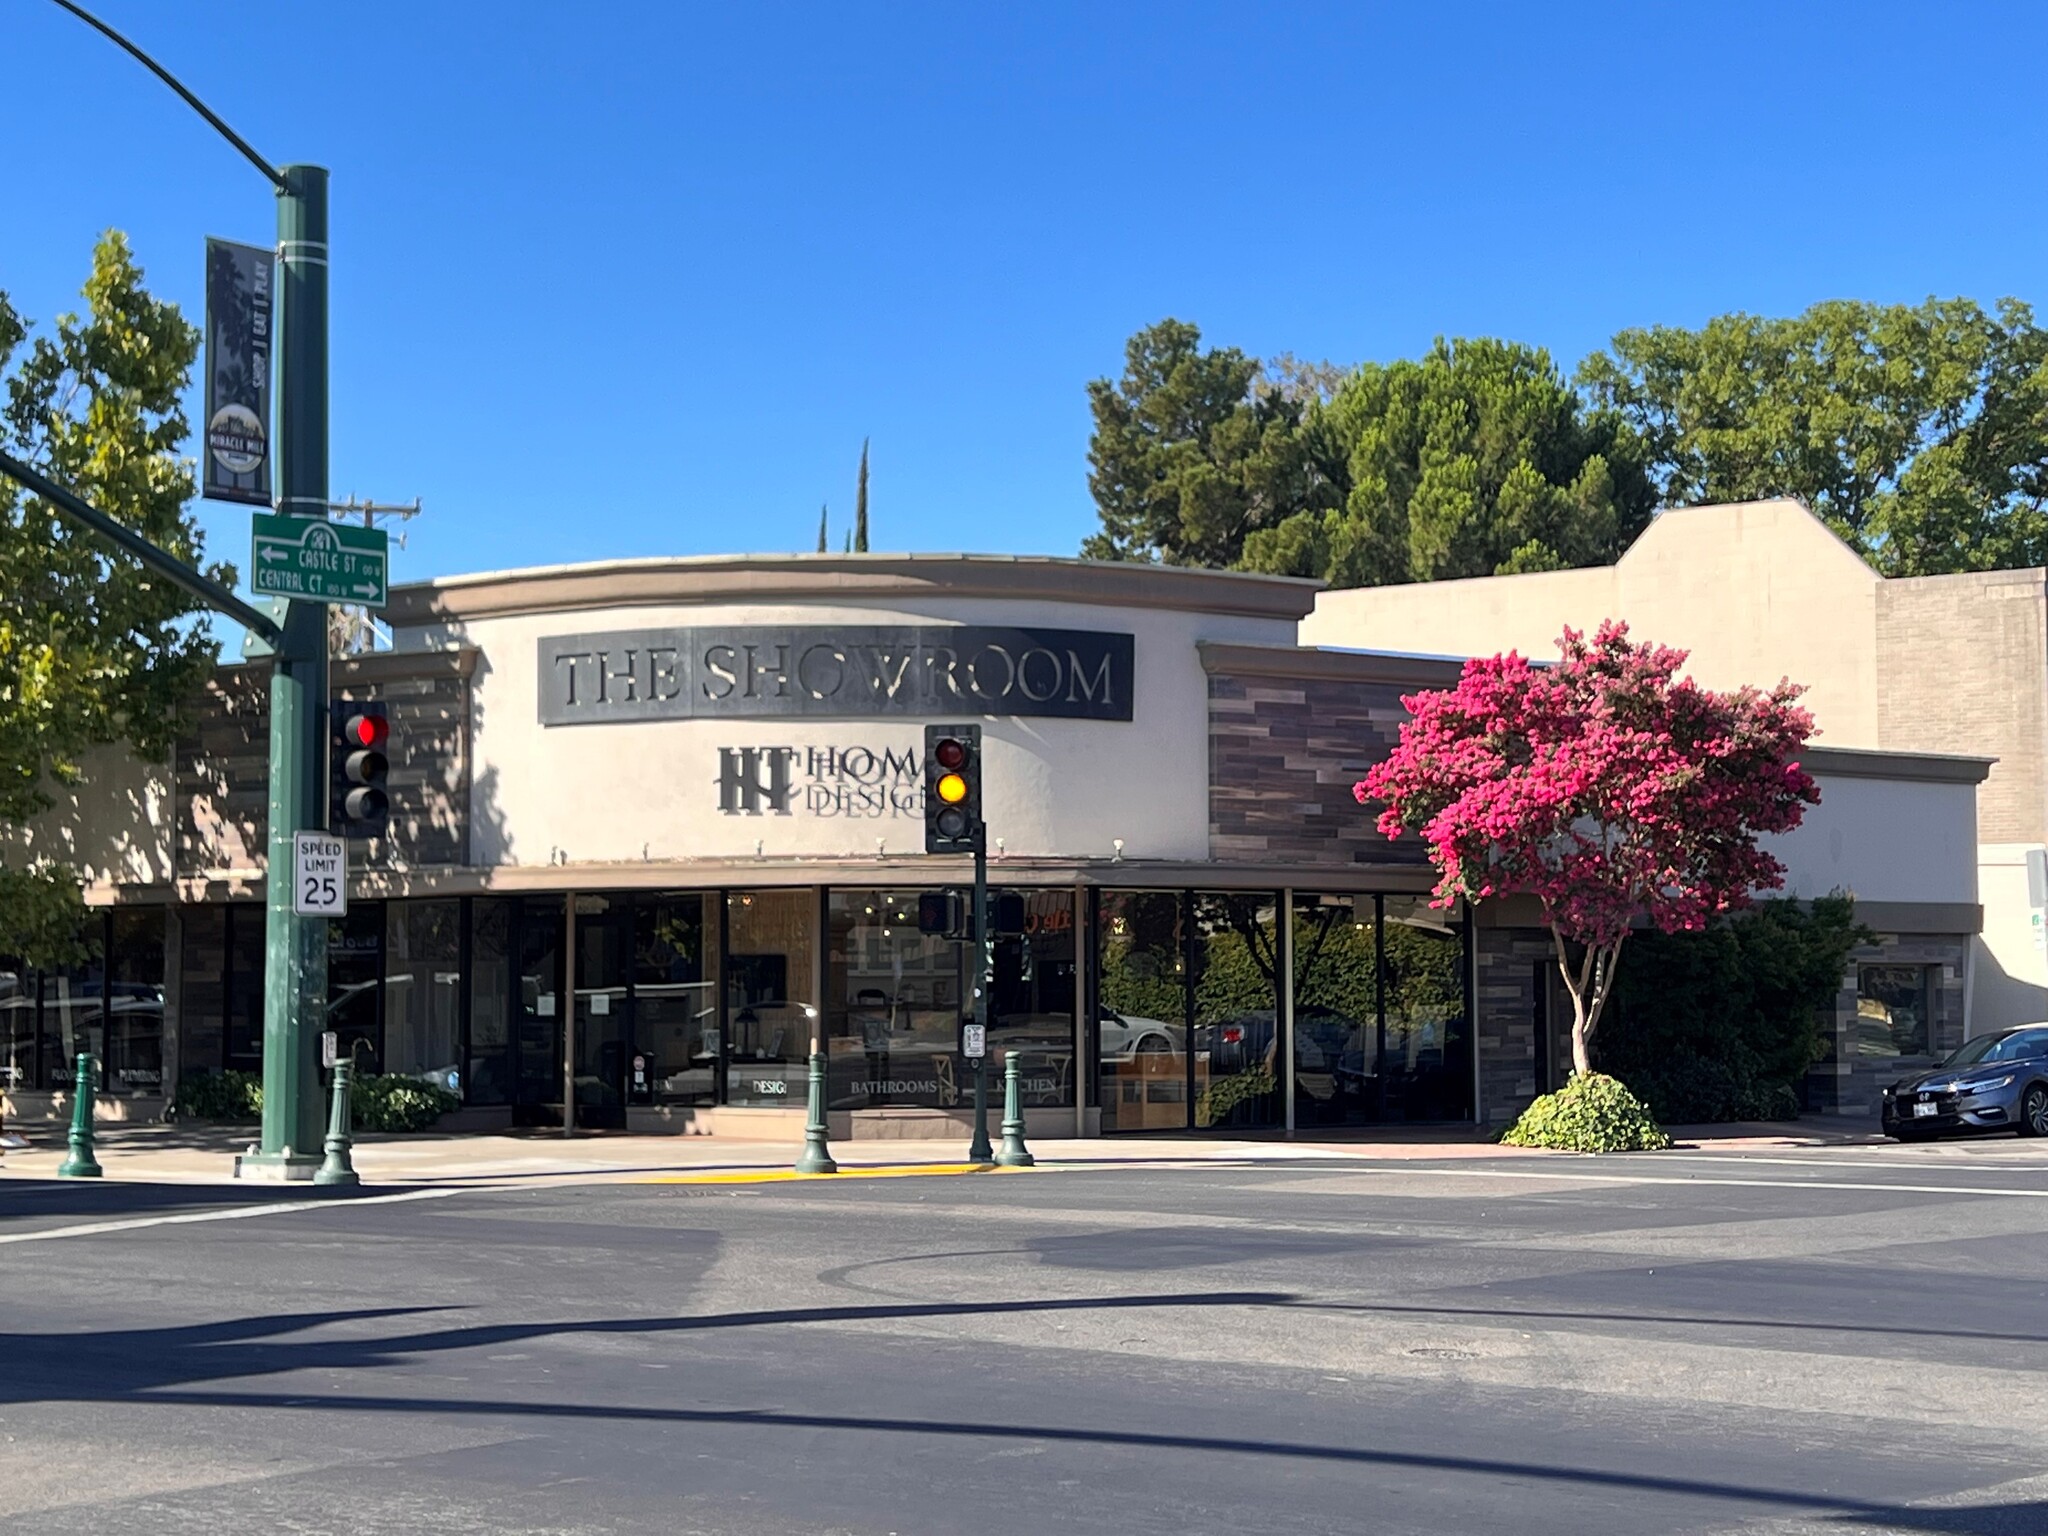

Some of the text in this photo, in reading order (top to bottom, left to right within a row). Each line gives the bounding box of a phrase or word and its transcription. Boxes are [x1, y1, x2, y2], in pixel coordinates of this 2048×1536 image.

[252, 260, 269, 389] SHOP EAT PLAY
[210, 433, 244, 452] MIRACLE
[298, 549, 339, 573] CASTLE
[343, 554, 357, 574] ST
[258, 568, 304, 592] CENTRAL
[308, 574, 323, 593] CT
[555, 643, 1114, 706] THE SHOWROOM
[804, 745, 921, 777] HOM
[301, 841, 342, 856] SPEED
[305, 859, 336, 873] LIMIT
[305, 877, 337, 905] 25
[850, 1080, 938, 1094] BATHROOMS
[996, 1078, 1057, 1093] KCHEN
